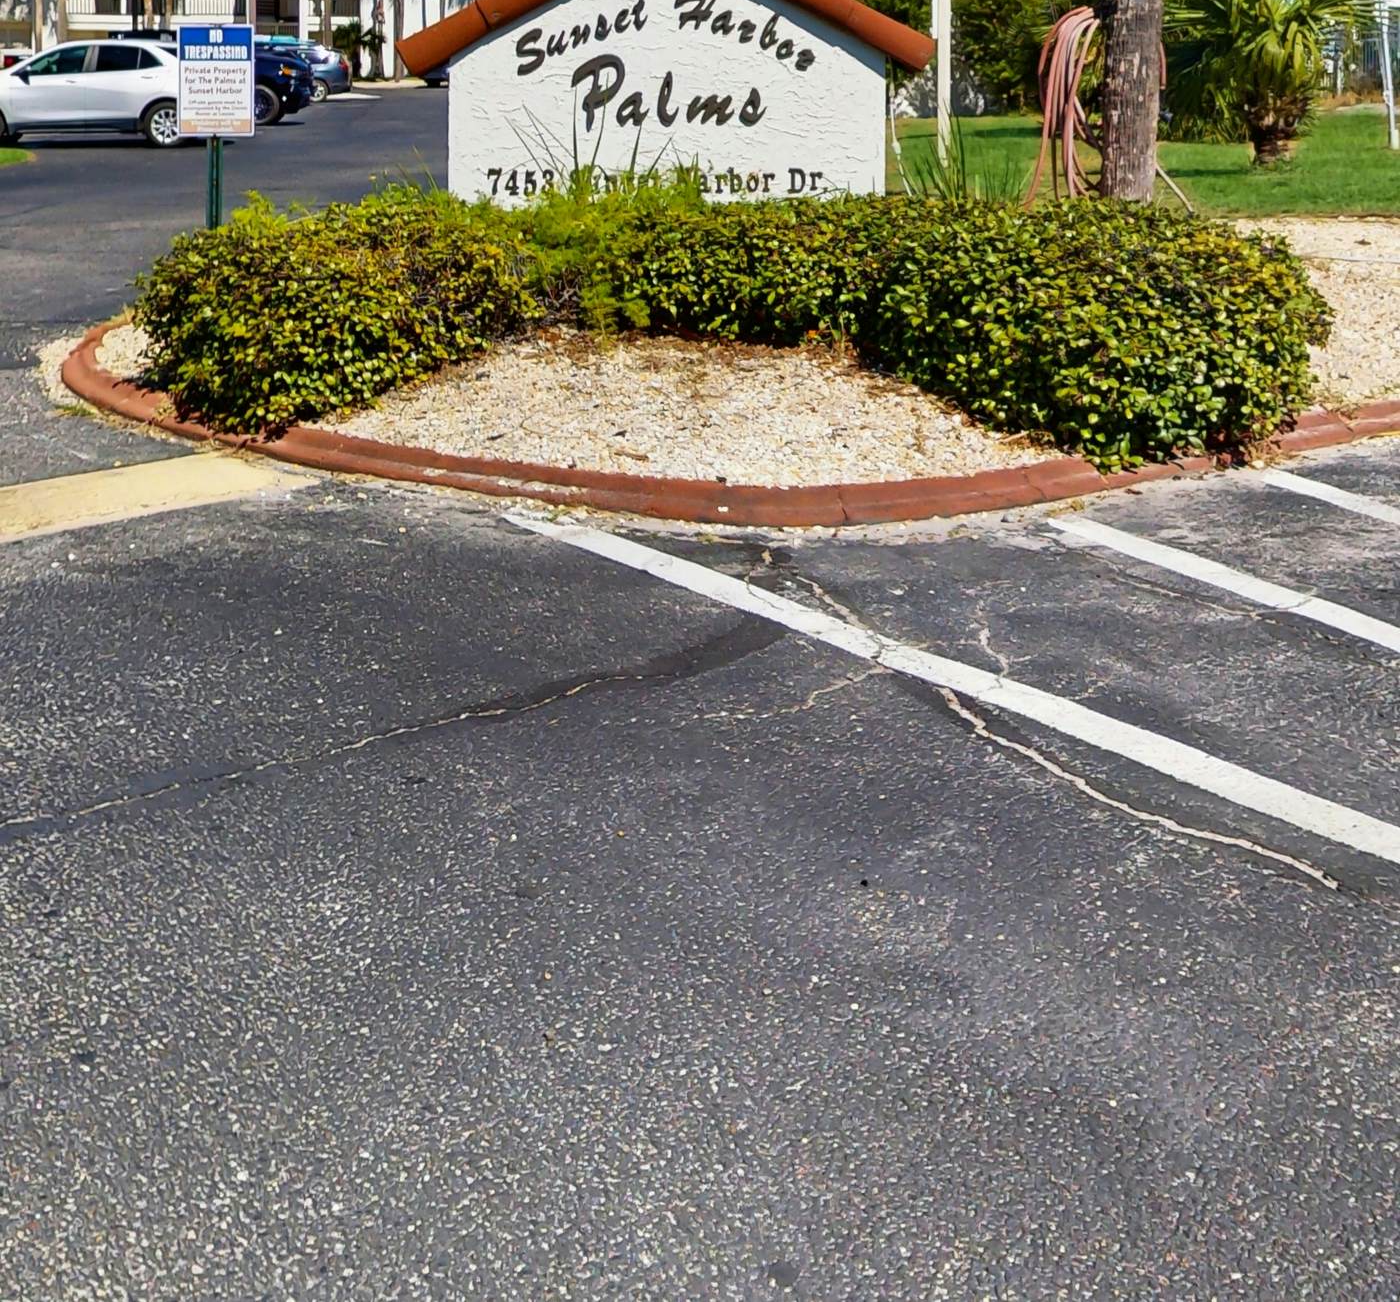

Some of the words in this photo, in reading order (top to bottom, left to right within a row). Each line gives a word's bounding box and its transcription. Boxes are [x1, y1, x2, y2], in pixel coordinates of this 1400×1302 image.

[209, 29, 223, 43] NO
[184, 45, 248, 59] TRESPASSING
[214, 67, 247, 76] Property
[571, 54, 767, 133] Palms
